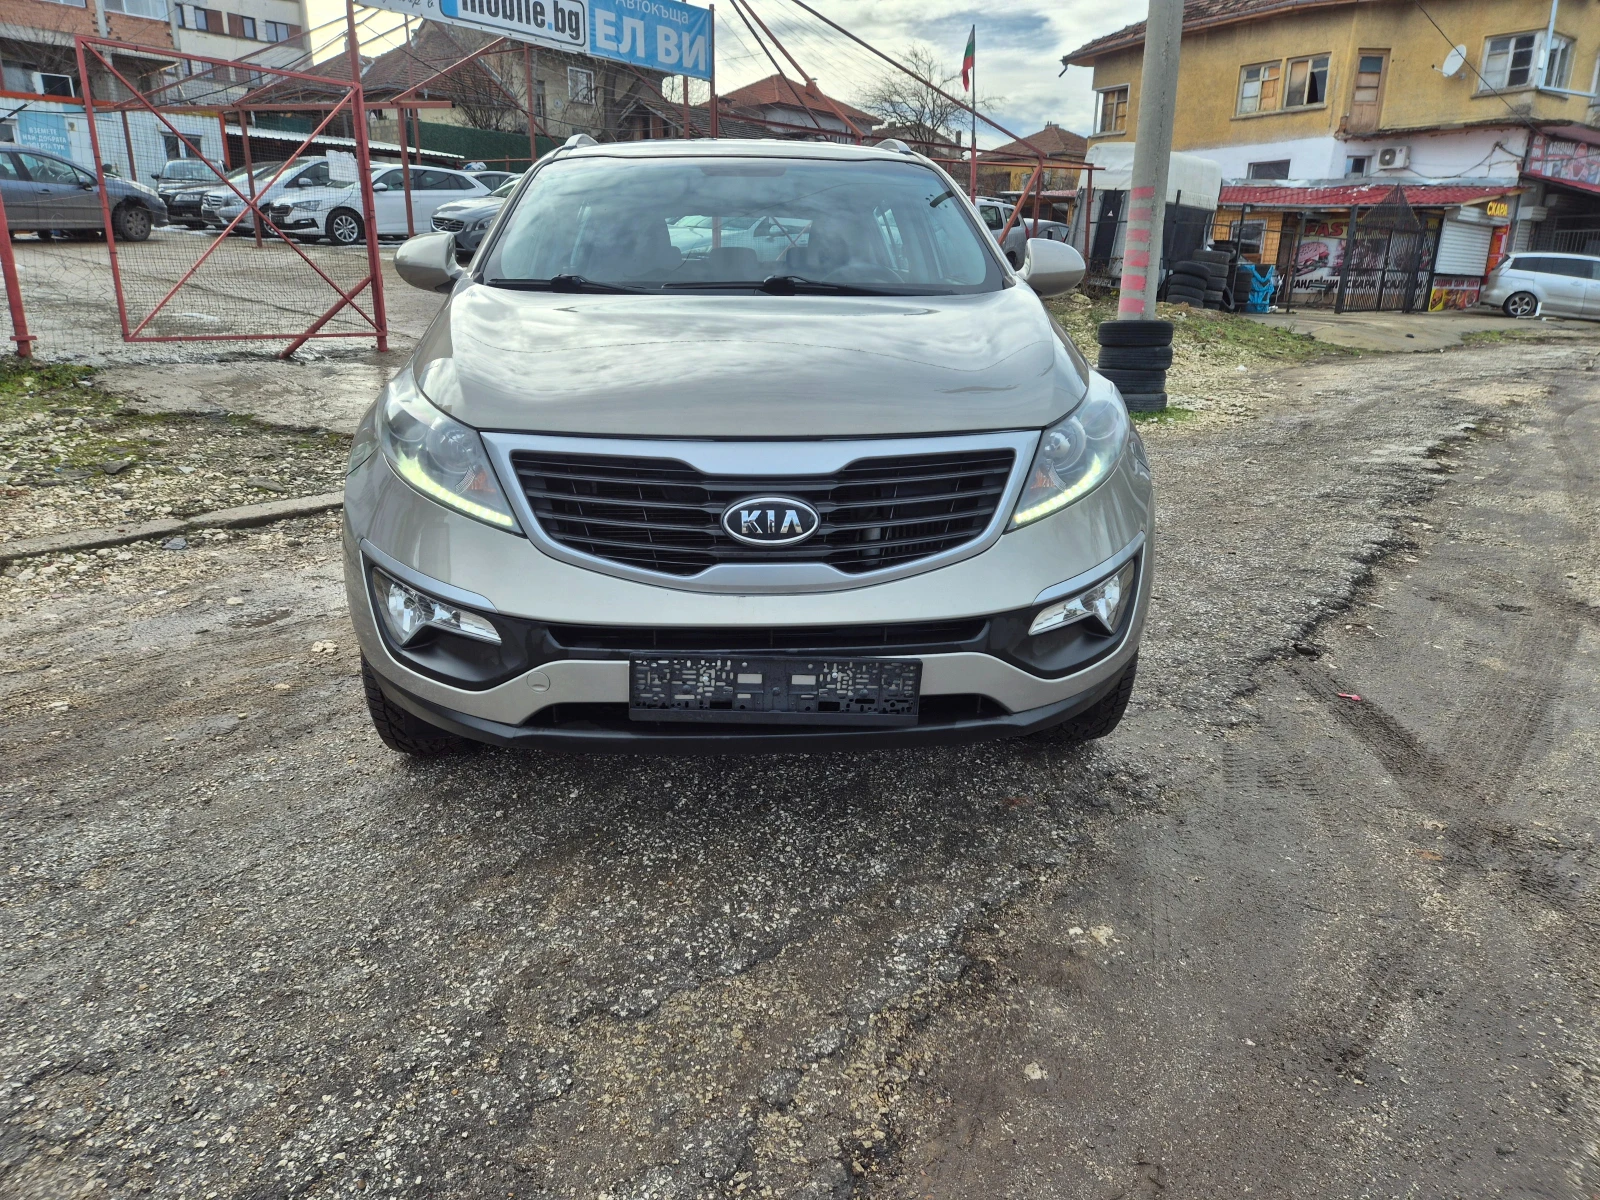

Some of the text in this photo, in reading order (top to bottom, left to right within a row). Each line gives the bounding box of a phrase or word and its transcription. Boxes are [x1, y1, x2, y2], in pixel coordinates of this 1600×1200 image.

[595, 8, 706, 71] ЕЛ ВИ
[1487, 201, 1508, 216] СКАРА
[740, 510, 803, 533] KIA
